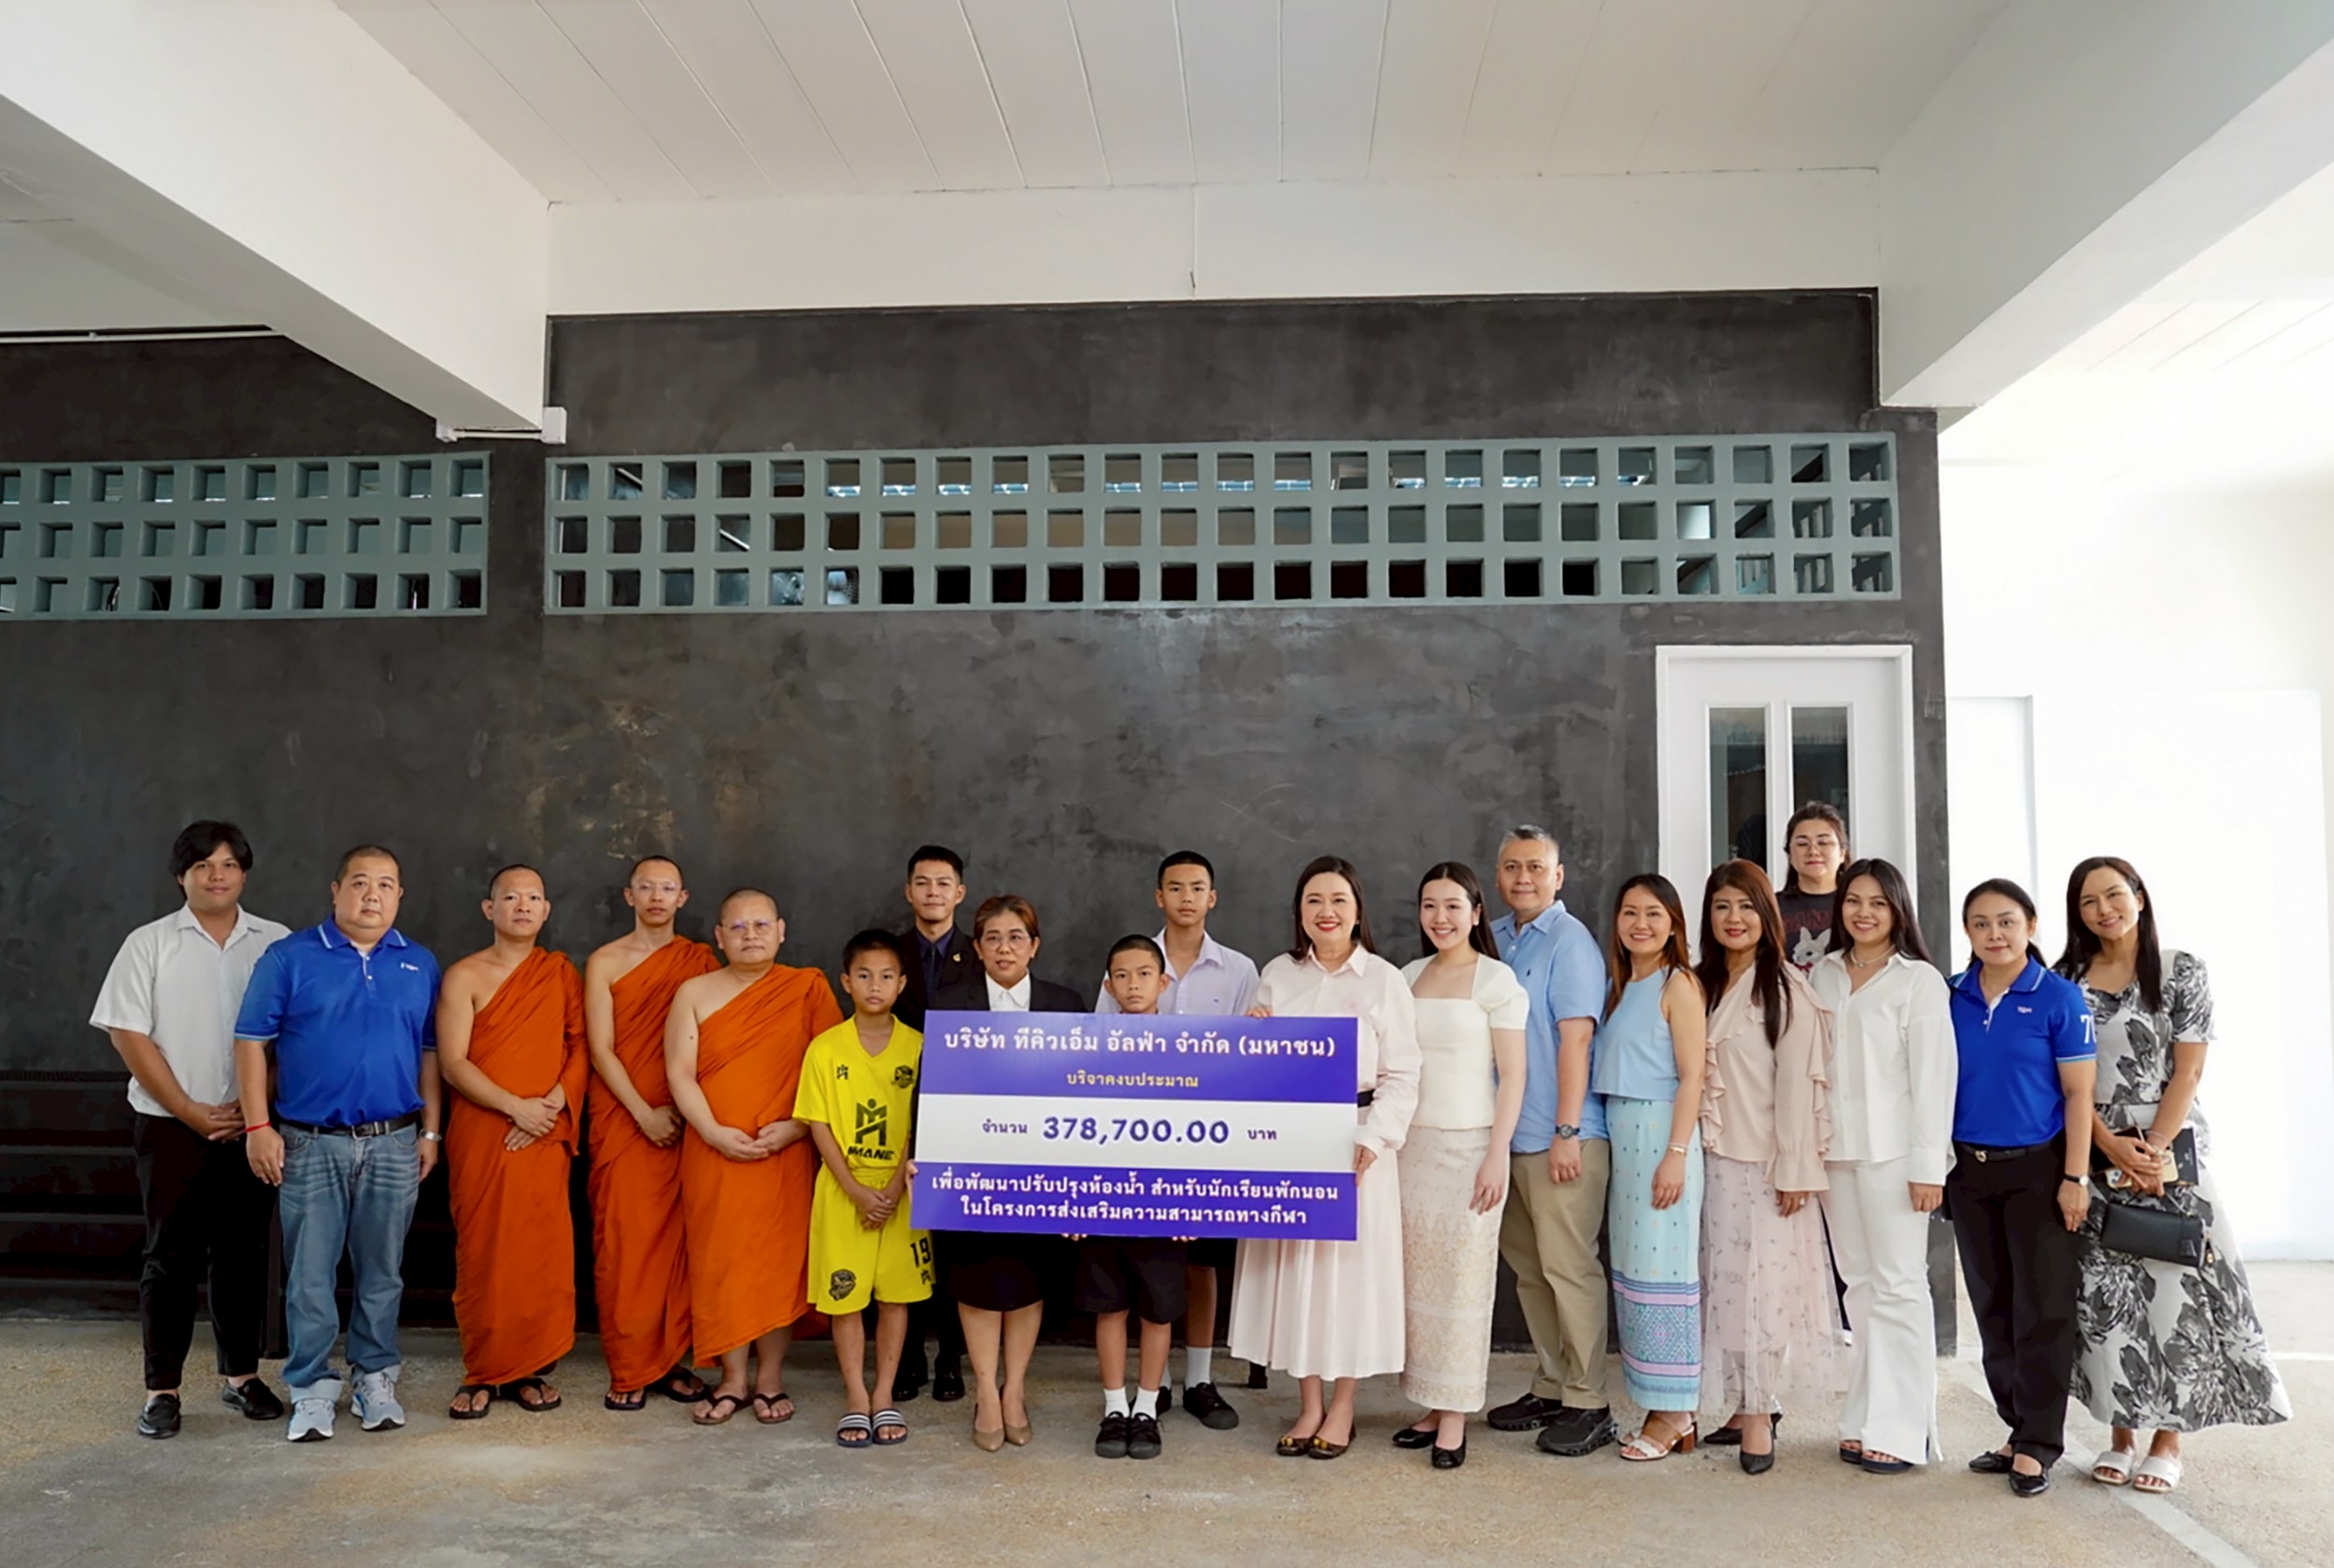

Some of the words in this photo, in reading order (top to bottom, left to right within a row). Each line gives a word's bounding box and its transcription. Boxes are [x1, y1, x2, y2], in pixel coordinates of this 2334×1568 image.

[945, 1026, 1005, 1049] บริษัท
[1013, 1026, 1098, 1051] ทีคิวเอ็ม
[1106, 1029, 1167, 1052] อัลฟ่า
[1174, 1031, 1230, 1054] จำกัด
[1238, 1035, 1335, 1057] (มหาชน)
[1066, 1069, 1199, 1088] บริจาคงบประมาณ
[982, 1119, 1028, 1134] จำนวน
[1043, 1117, 1230, 1145] 378,700.00
[1247, 1128, 1277, 1141] บาท
[932, 1168, 1145, 1199] เพื่อพัฒนาปรับปรุงห้องน้ำ
[1151, 1177, 1338, 1200] สำหรับนักเรียนพักนอน
[961, 1195, 1306, 1224] ในโครงการส่งเสริมความสามารถทางกีฬา
[910, 1237, 931, 1268] 19
